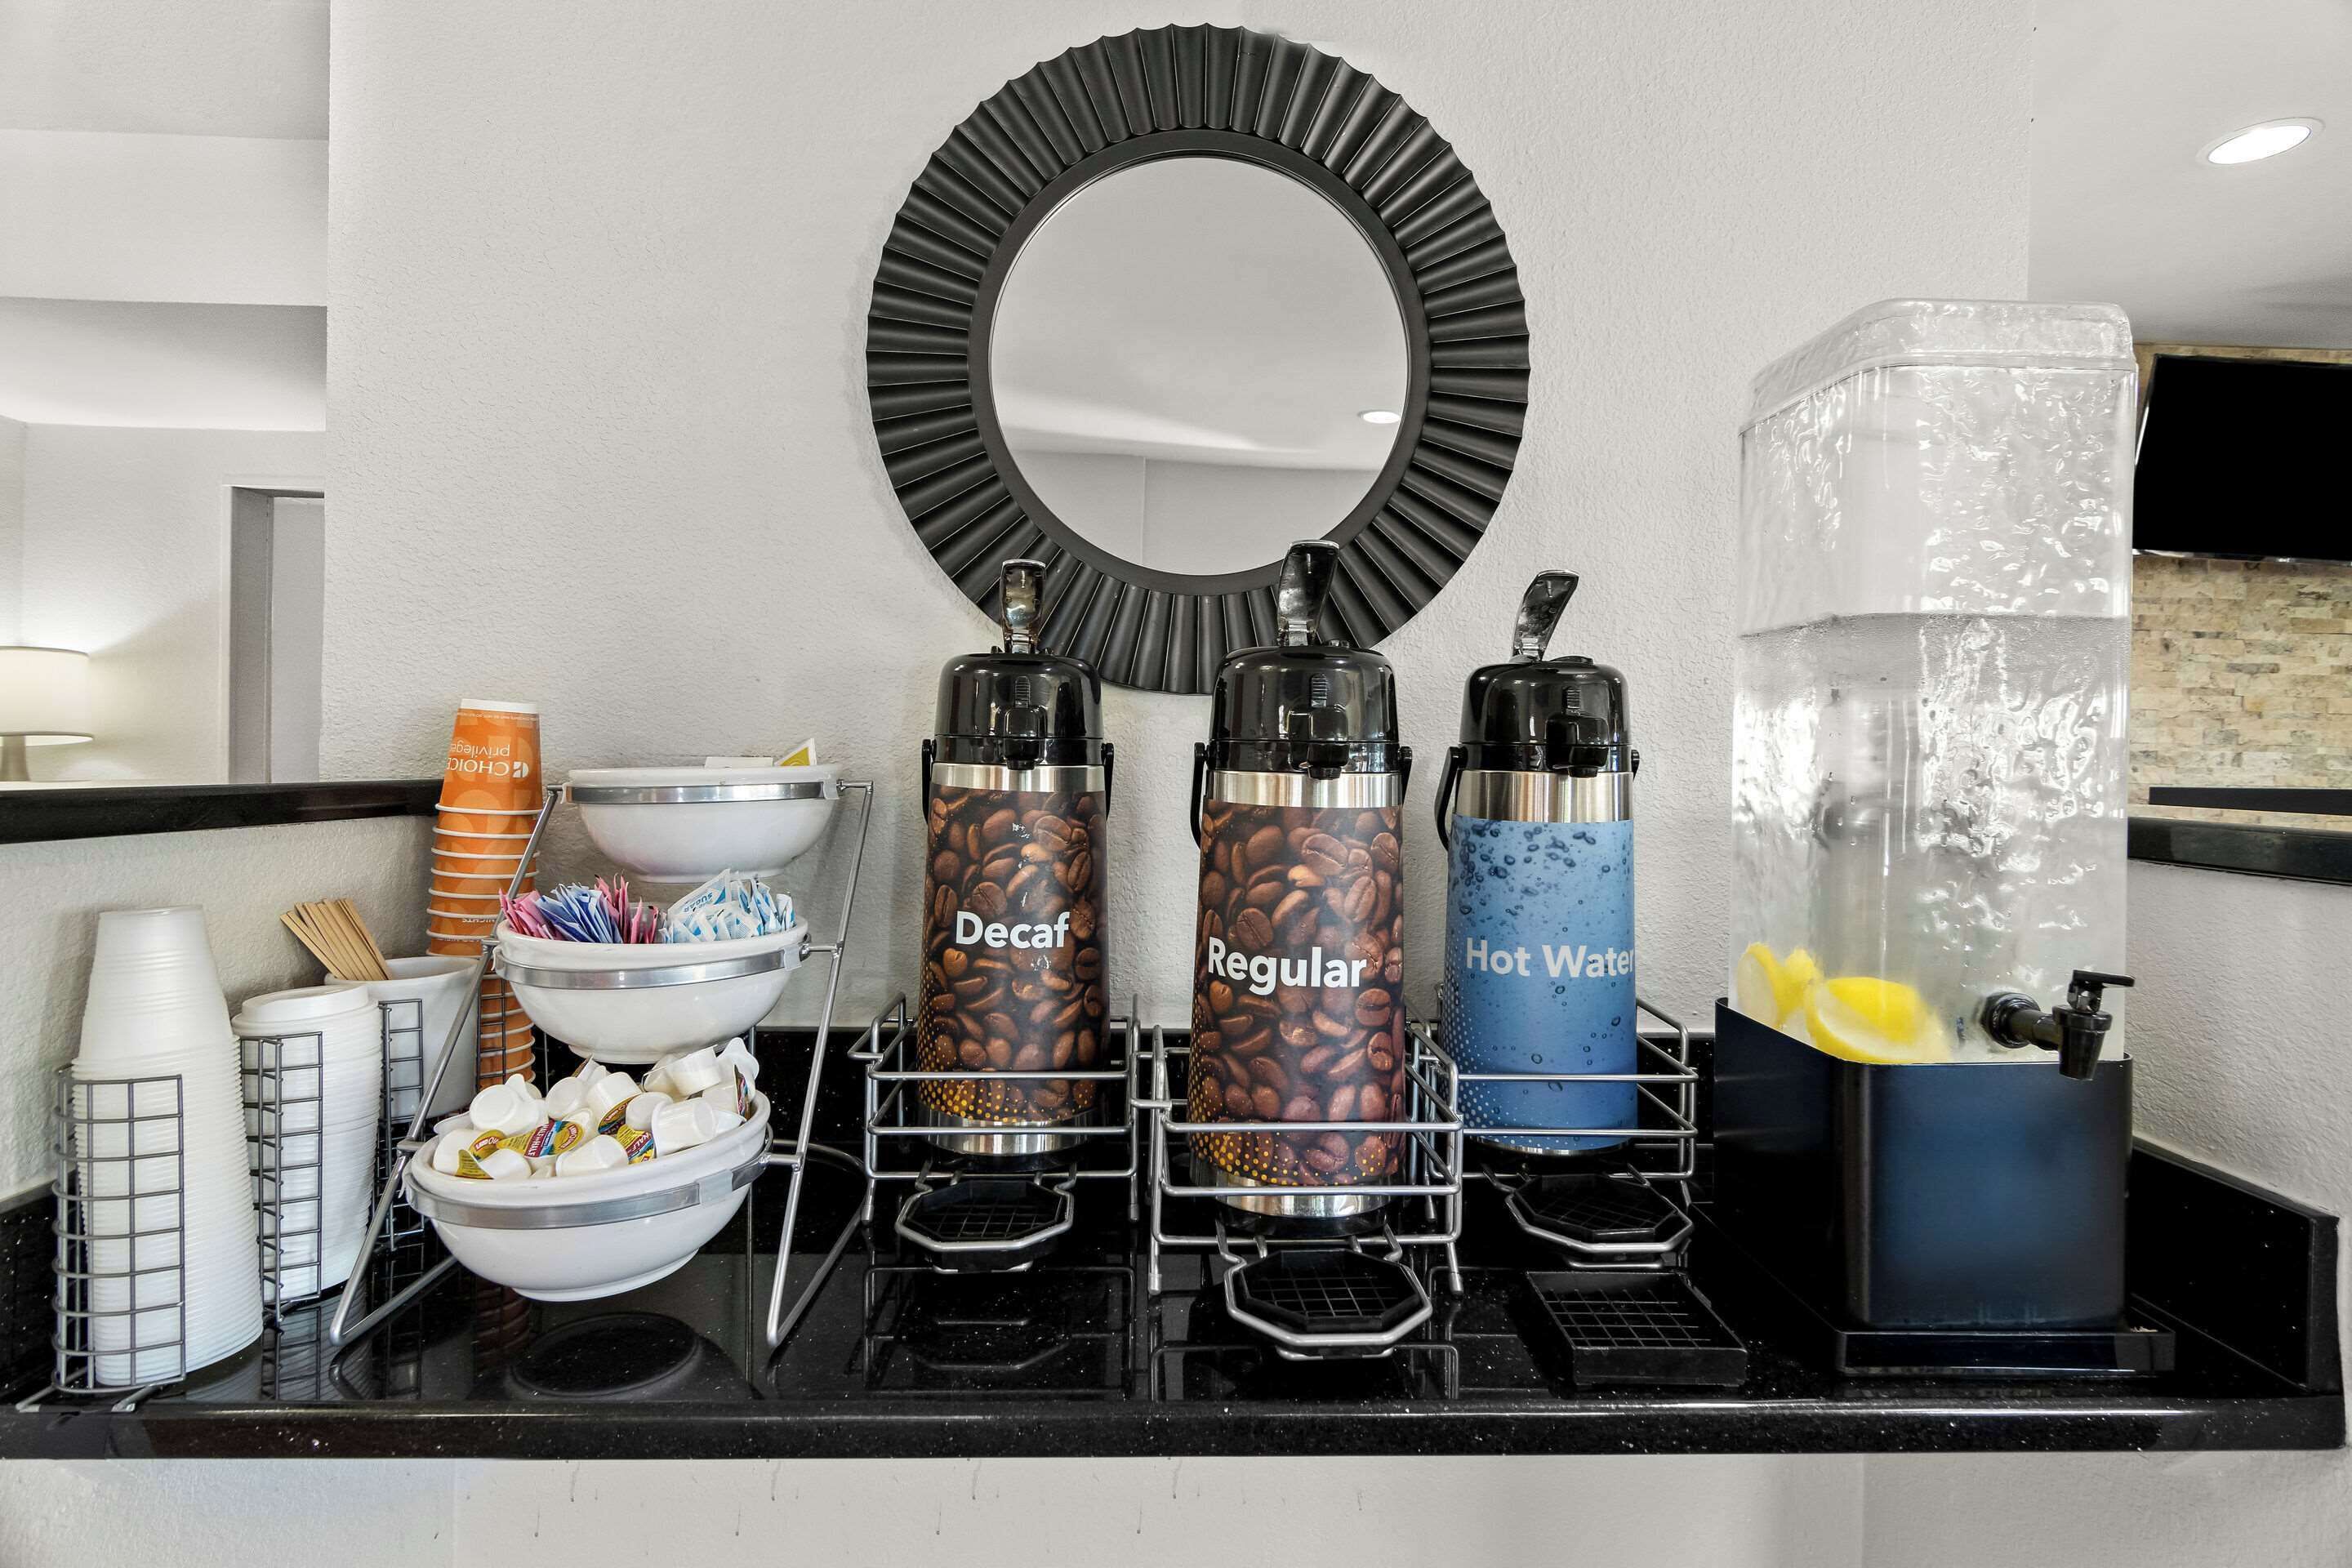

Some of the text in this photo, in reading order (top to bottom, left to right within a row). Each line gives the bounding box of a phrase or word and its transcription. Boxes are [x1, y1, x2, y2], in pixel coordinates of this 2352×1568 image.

[446, 757, 510, 776] CHOICE
[683, 891, 714, 913] SUGAR
[955, 910, 1071, 949] Decaf
[1207, 936, 1368, 996] Regular
[1466, 937, 1634, 978] Hot Water
[528, 1140, 541, 1156] HALF
